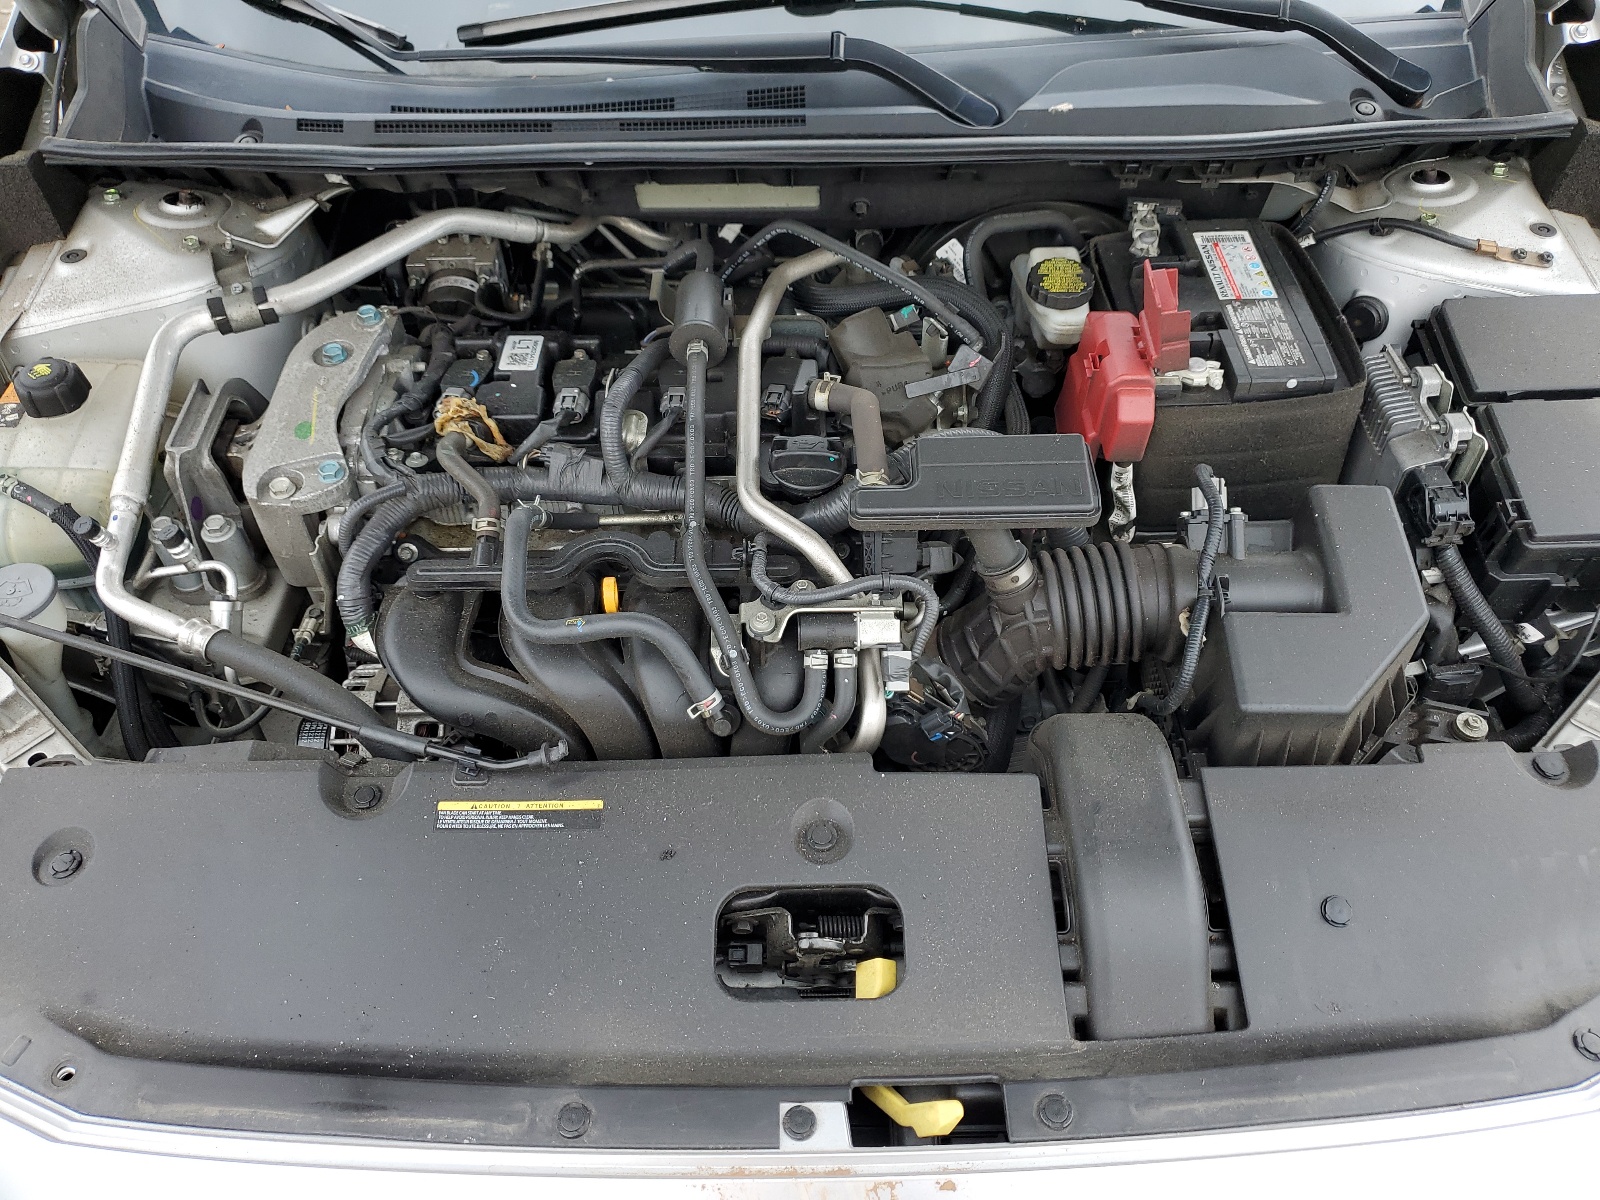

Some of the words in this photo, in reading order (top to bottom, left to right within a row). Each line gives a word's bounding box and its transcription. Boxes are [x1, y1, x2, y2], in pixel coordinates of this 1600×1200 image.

[1201, 244, 1217, 271] NISSAN
[517, 339, 532, 350] L1
[937, 477, 1083, 498] NISSAN
